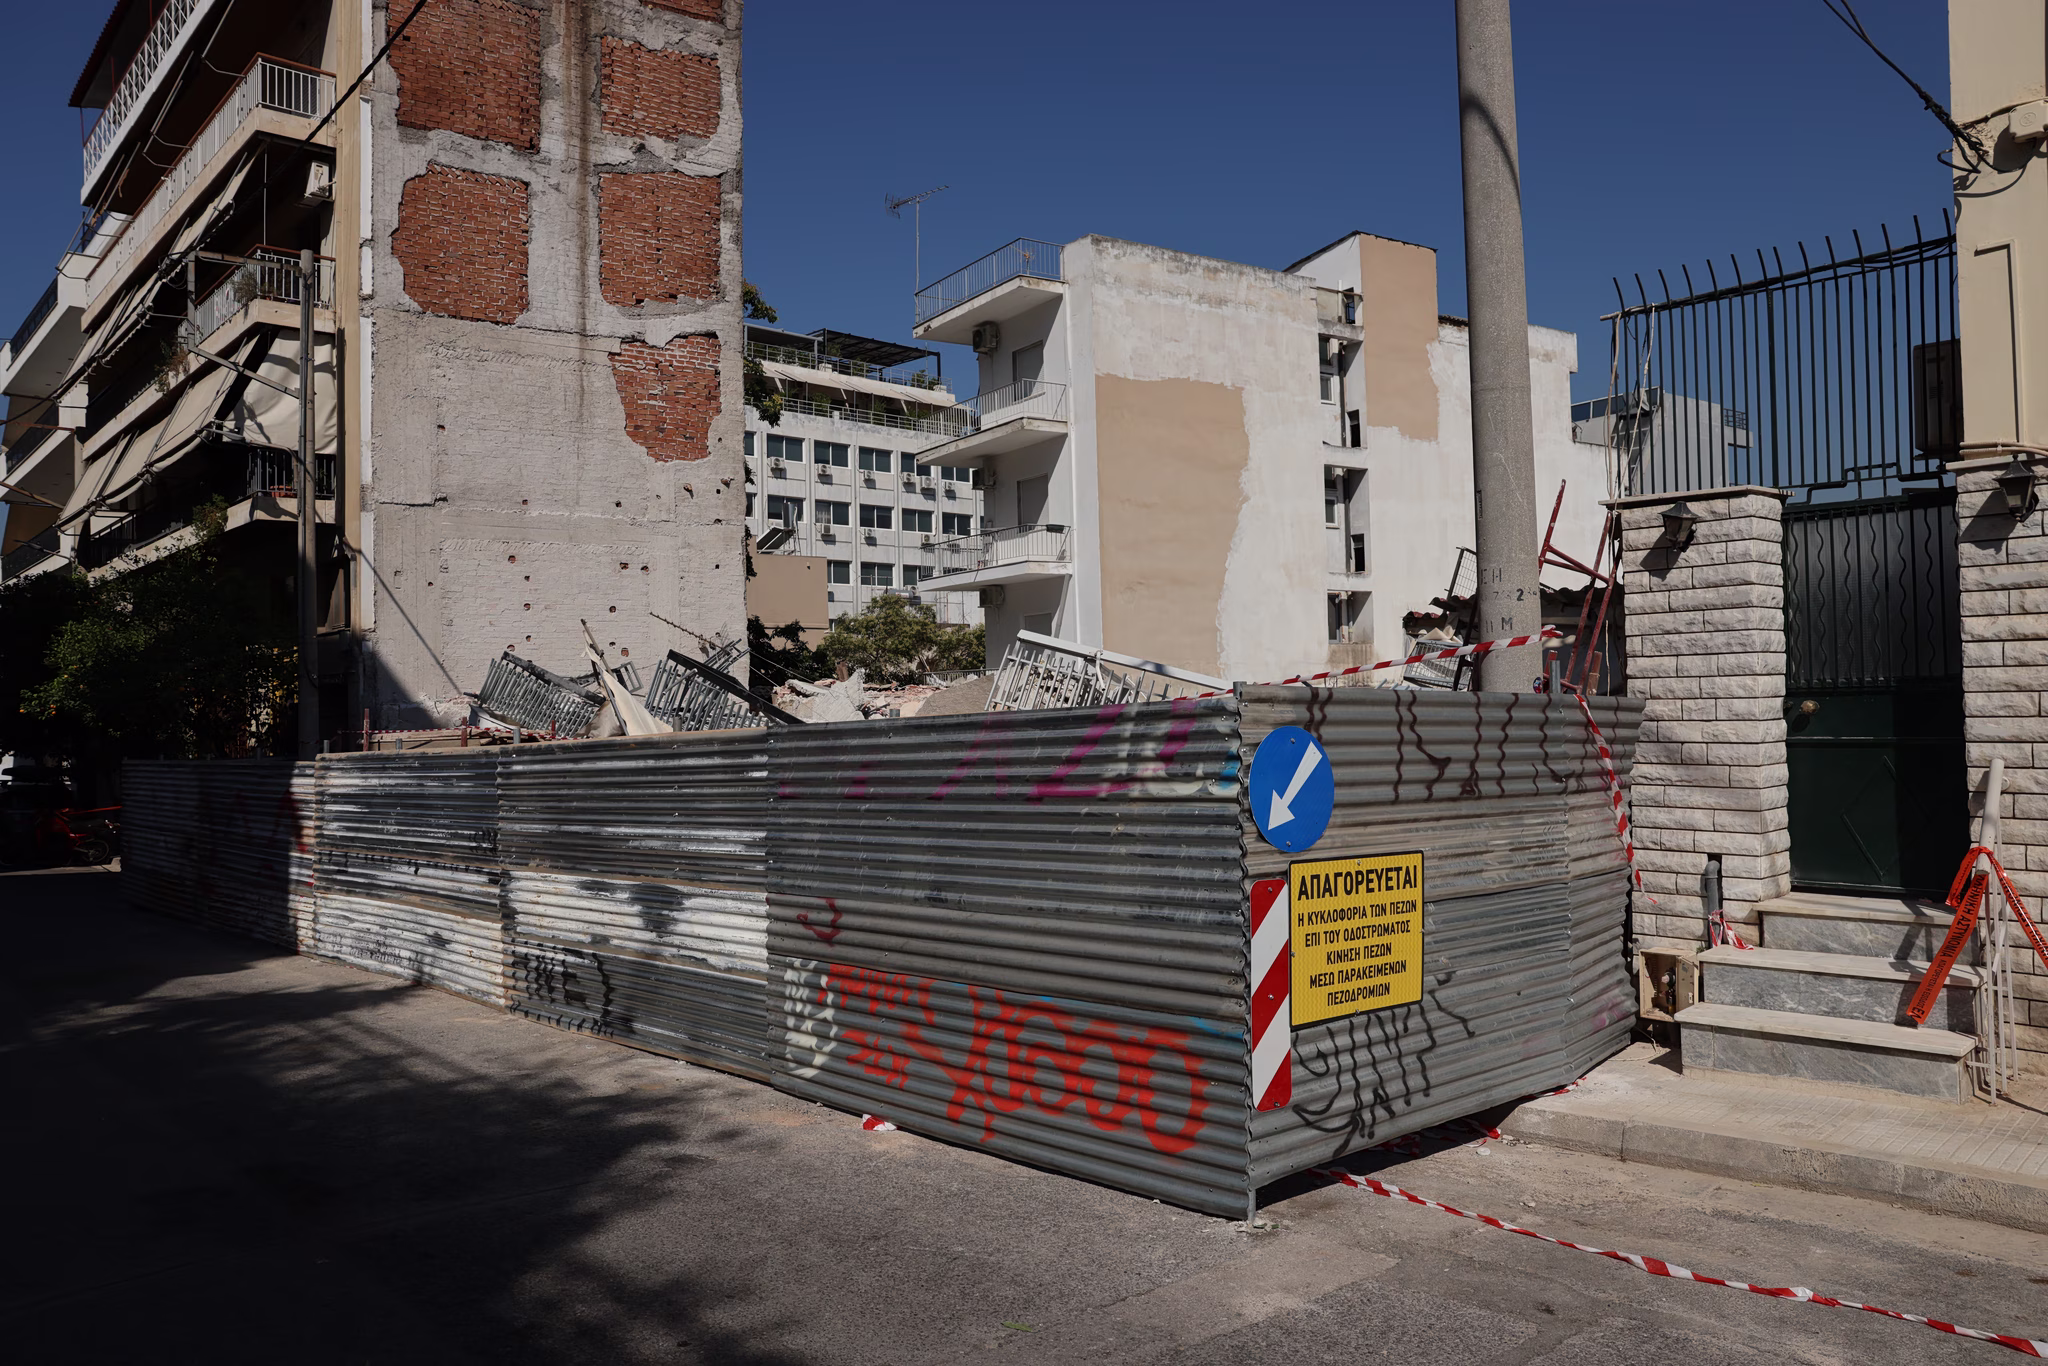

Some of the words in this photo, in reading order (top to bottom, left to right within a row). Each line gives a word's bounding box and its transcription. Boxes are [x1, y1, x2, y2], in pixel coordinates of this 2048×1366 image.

[1297, 865, 1418, 901] ΑΠΑΓΟΡΕΥΕΤΑΙ
[1297, 913, 1305, 927] Η
[1307, 905, 1367, 927] ΚΥΚΛΟΦΟΡΙΑ
[1370, 903, 1387, 918] ΤΩΝ
[1390, 899, 1417, 916] ΠΕΖΩΝ
[1305, 932, 1320, 948] ΕΠΙ
[1323, 929, 1341, 945] ΤΟΥ
[1343, 920, 1411, 942] ΟΔΟΣΤΡΩΜΑΤΟΣ
[1939, 915, 1972, 958] ΑΣΤΥΝΟΜΙΑ
[1326, 947, 1361, 965] ΚΙΝΗΣΗ
[1363, 942, 1392, 960] ΠΕΖΩΝ
[1309, 972, 1335, 989] ΜΕΣΩ
[1337, 960, 1407, 985] ΠΑΡΑΚΕΙΜΕΝΩΝ
[1327, 982, 1391, 1007] ΠΕΖΟΔΡΟΜΙΩΝ
